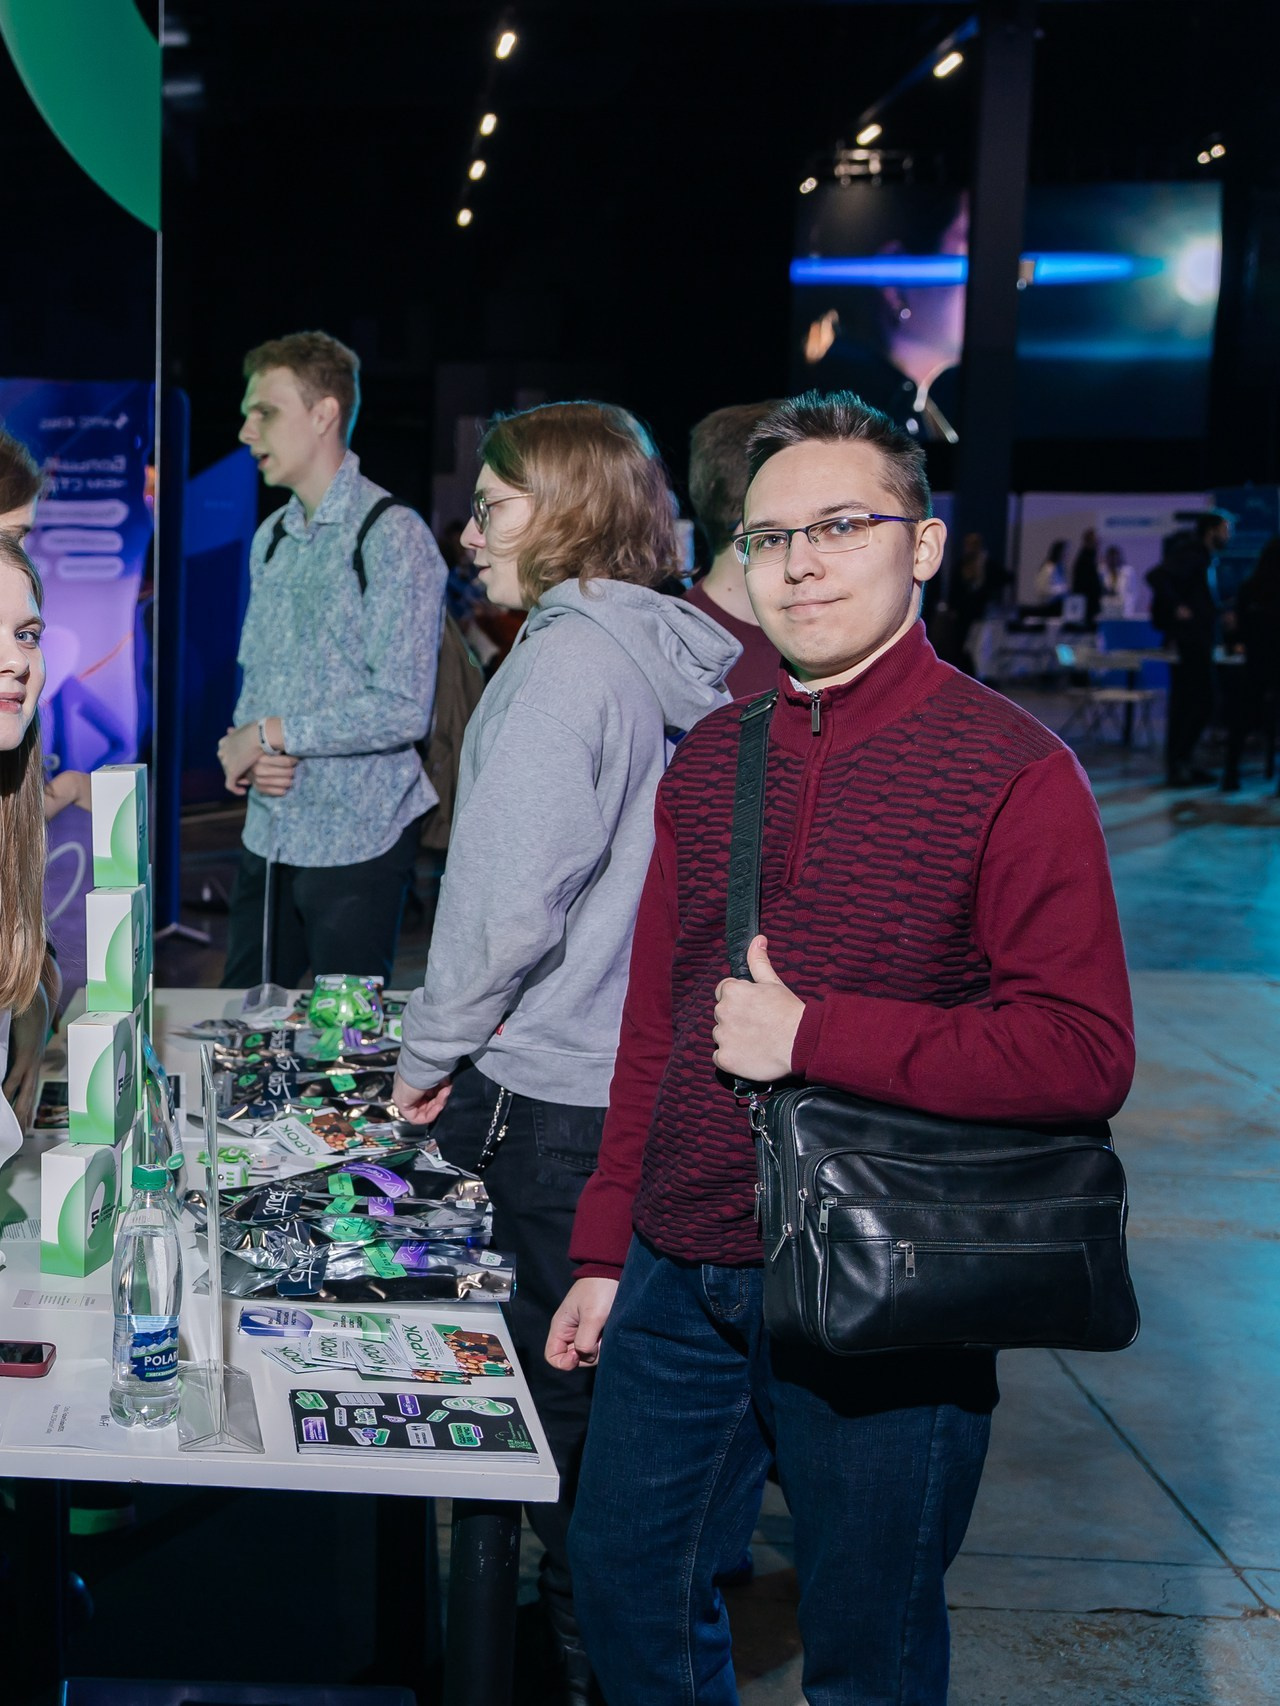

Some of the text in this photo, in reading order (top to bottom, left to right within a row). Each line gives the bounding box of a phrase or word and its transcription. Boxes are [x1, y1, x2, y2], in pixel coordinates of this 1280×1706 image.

[279, 1124, 315, 1156] КРОК
[91, 1209, 100, 1229] 5
[320, 1336, 338, 1359] КРОК
[404, 1324, 432, 1361] КРОК
[277, 1346, 317, 1369] КРОК
[363, 1344, 389, 1366] КРОК
